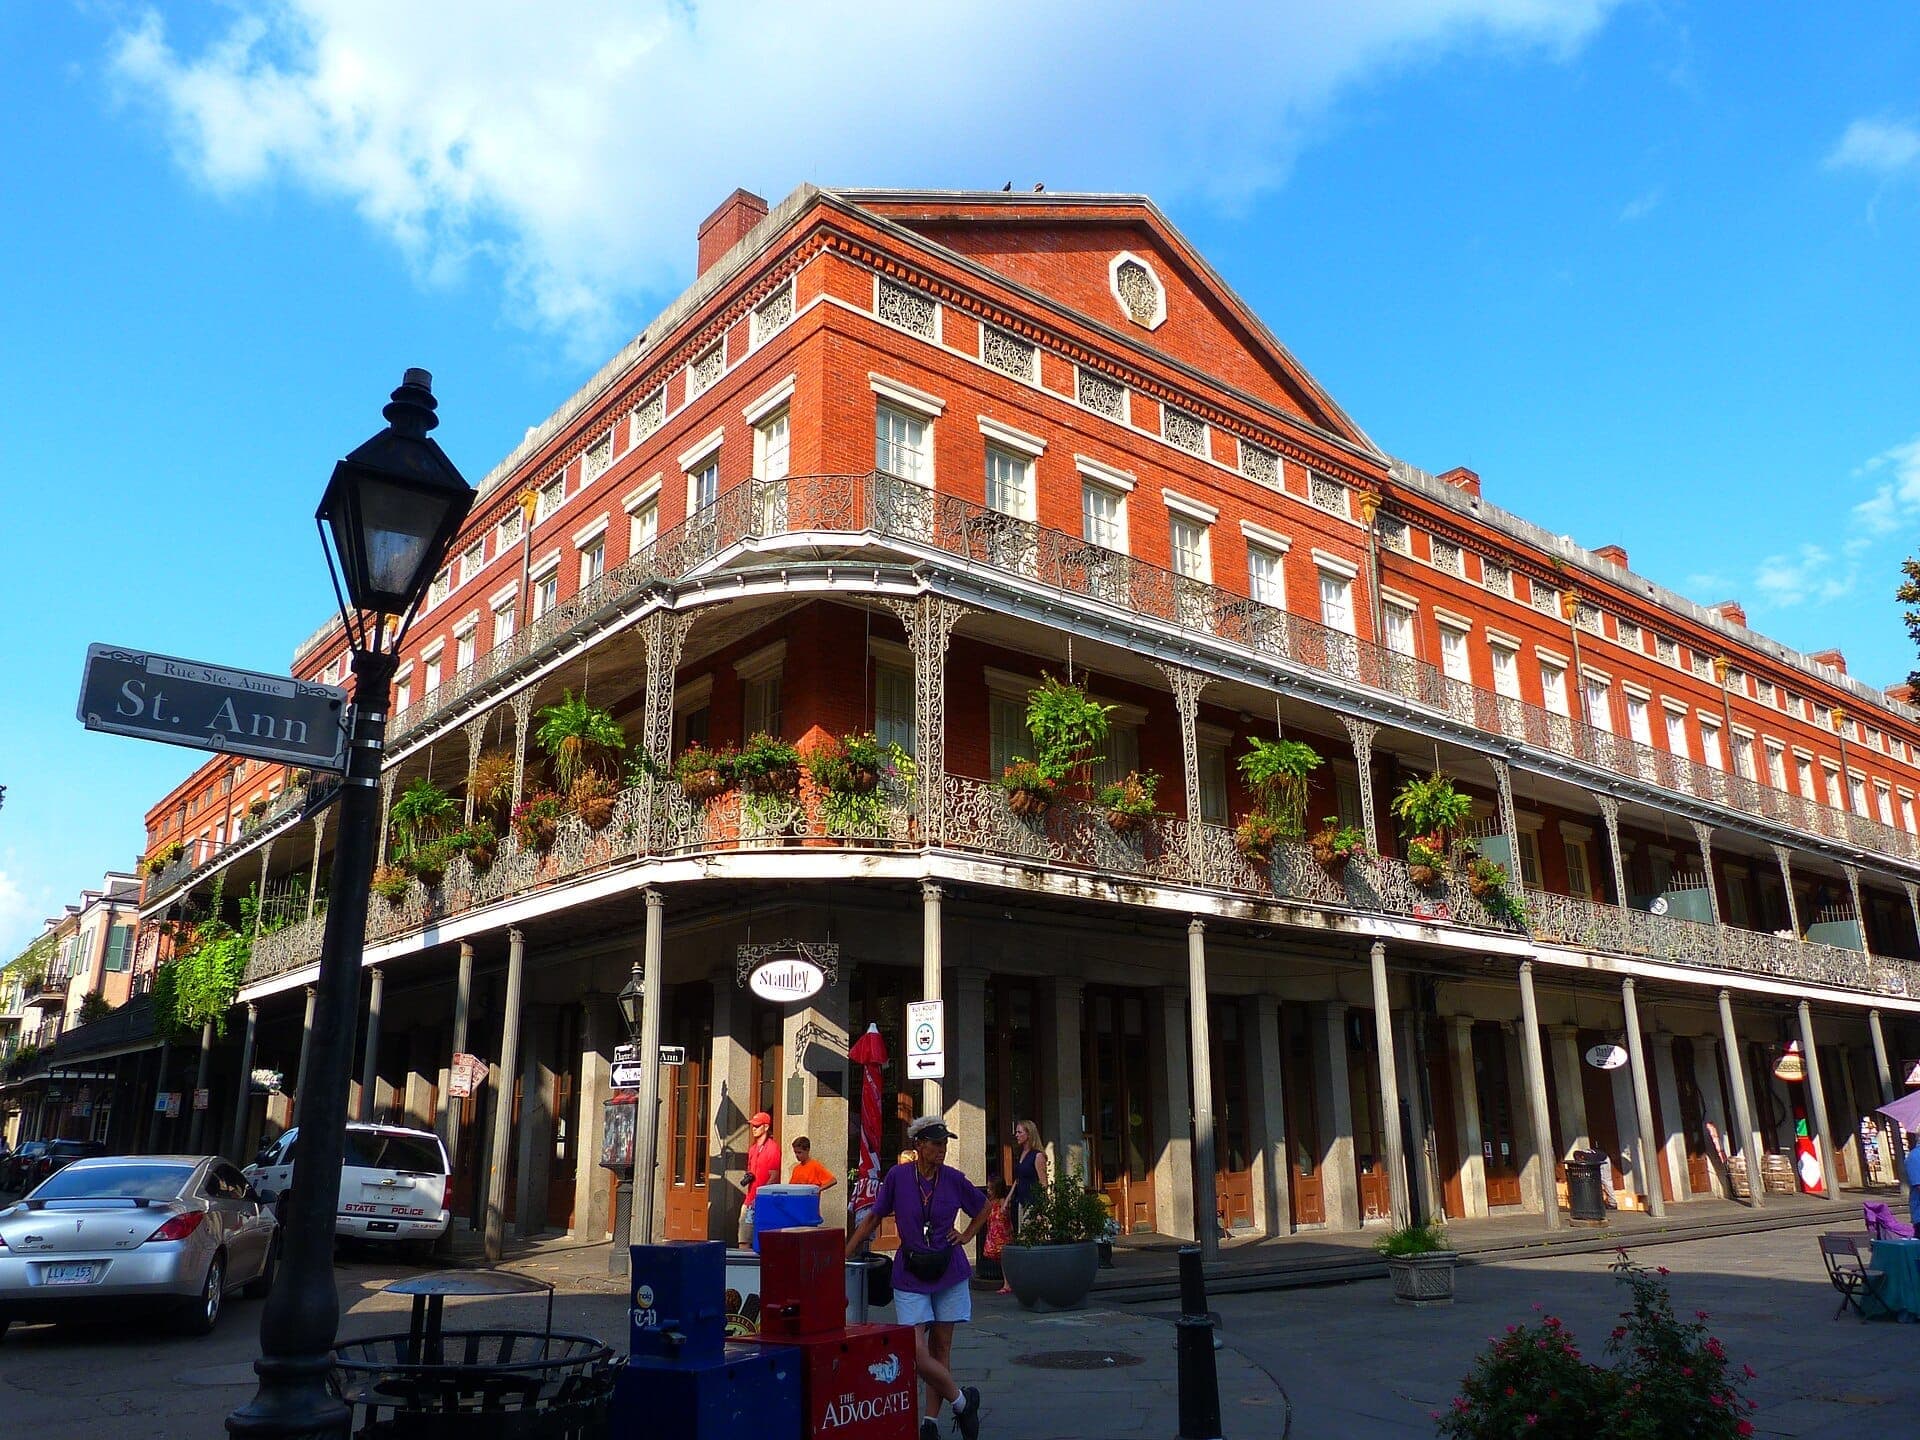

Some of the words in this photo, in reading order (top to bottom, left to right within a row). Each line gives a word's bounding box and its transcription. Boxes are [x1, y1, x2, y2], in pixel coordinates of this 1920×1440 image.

[163, 661, 196, 676] Rue
[201, 669, 232, 686] Ste.
[238, 676, 282, 695] Anne
[115, 678, 181, 724] St.
[205, 695, 309, 745] Ann
[659, 1053, 679, 1063] Ann
[344, 1203, 377, 1213] STATE
[391, 1207, 425, 1216] POLICE
[75, 1266, 92, 1278] 153
[839, 1392, 856, 1405] THE
[820, 1390, 910, 1430] ADVOCATE
